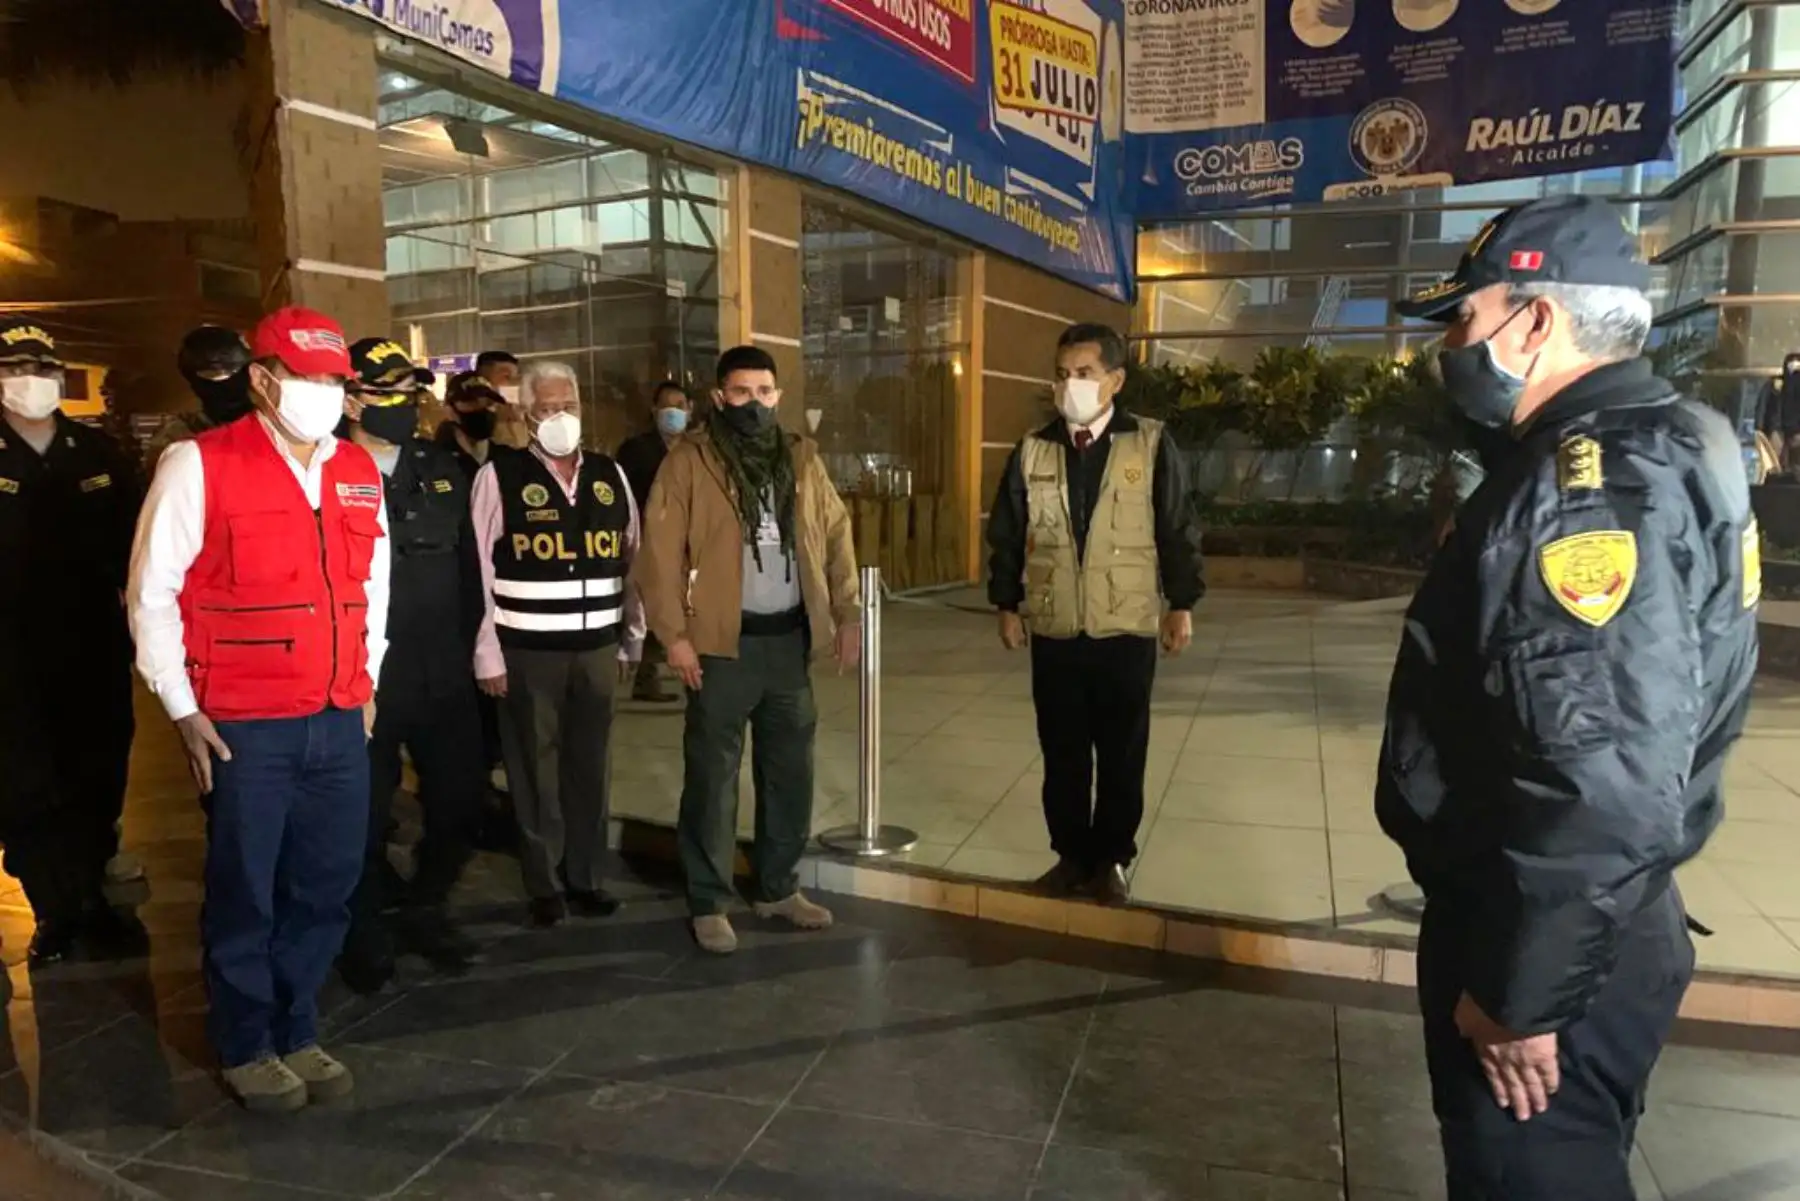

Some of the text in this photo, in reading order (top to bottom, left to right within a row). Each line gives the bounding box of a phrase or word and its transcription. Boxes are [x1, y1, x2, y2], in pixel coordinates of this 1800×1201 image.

[873, 0, 917, 29] ROS
[919, 0, 952, 51] USOS
[1127, 0, 1249, 16] CORONAVIR
[1000, 12, 1059, 56] PRÓRROGA
[999, 47, 1026, 98] 31
[1030, 57, 1096, 116] JULIO
[1466, 107, 1555, 152] RAÚL
[1558, 98, 1646, 141] DÍAZ
[1174, 137, 1305, 180] COMAS
[1511, 142, 1595, 166] Alcalde
[945, 160, 961, 200] al
[966, 164, 1001, 217] buen
